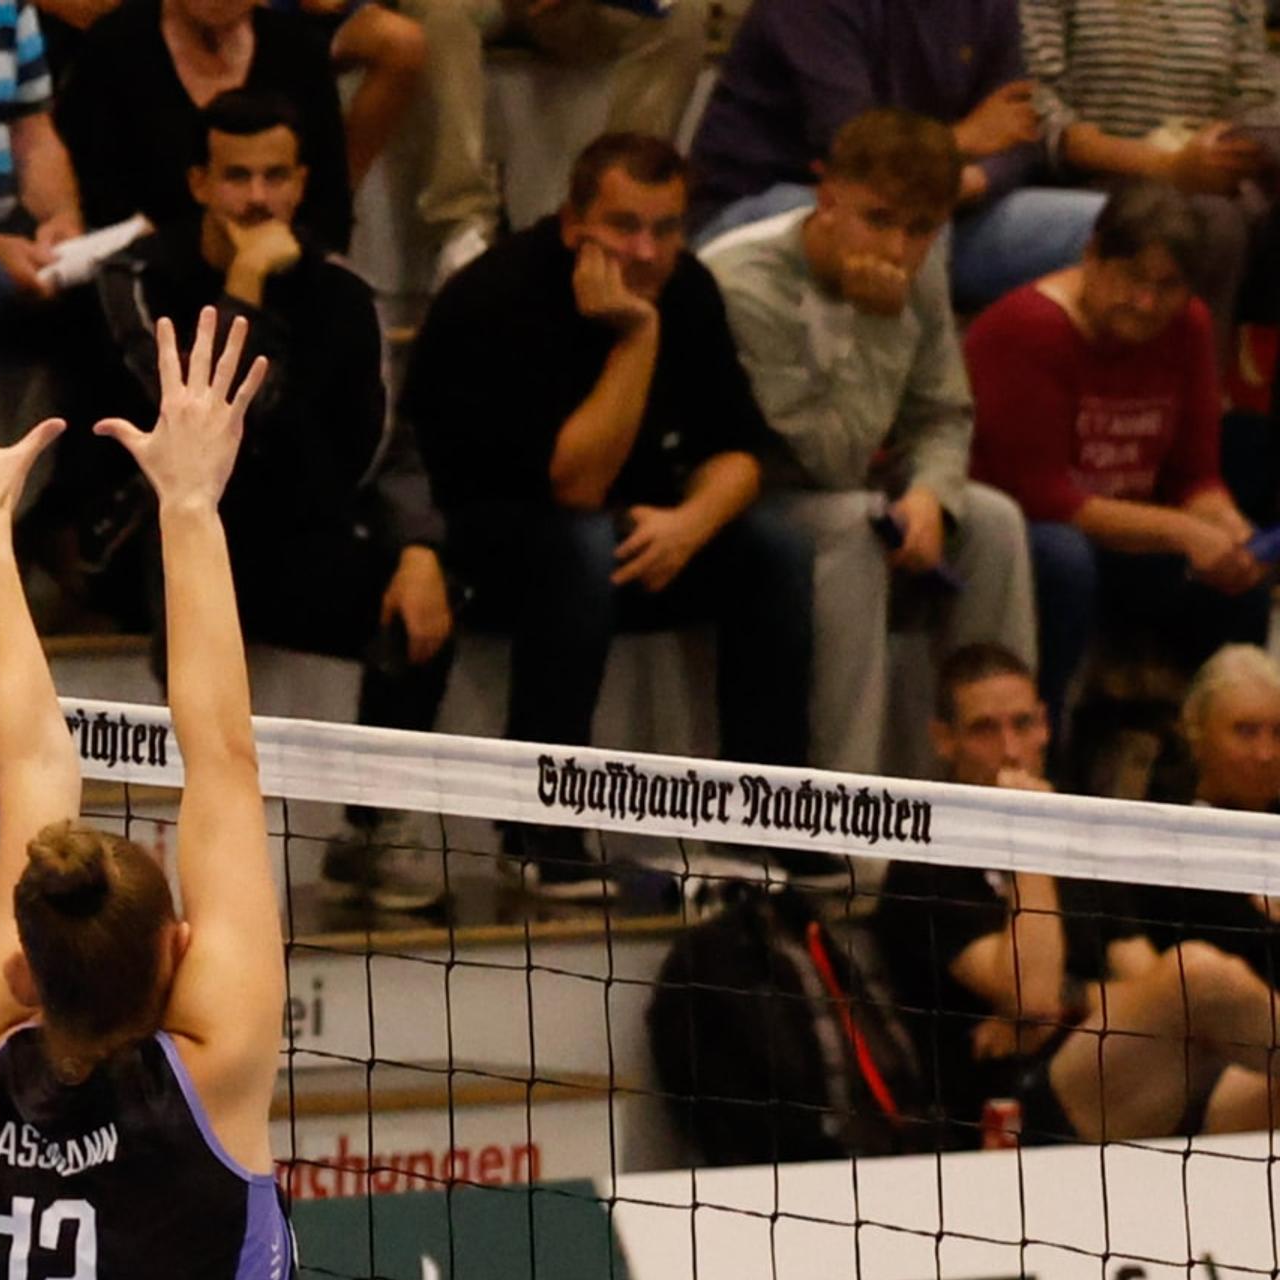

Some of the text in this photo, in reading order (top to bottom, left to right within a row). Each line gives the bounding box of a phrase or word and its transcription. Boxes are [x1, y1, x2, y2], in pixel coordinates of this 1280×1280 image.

[67, 708, 168, 767] richten
[740, 775, 931, 845] Nachrichten
[274, 1134, 543, 1200] achungen
